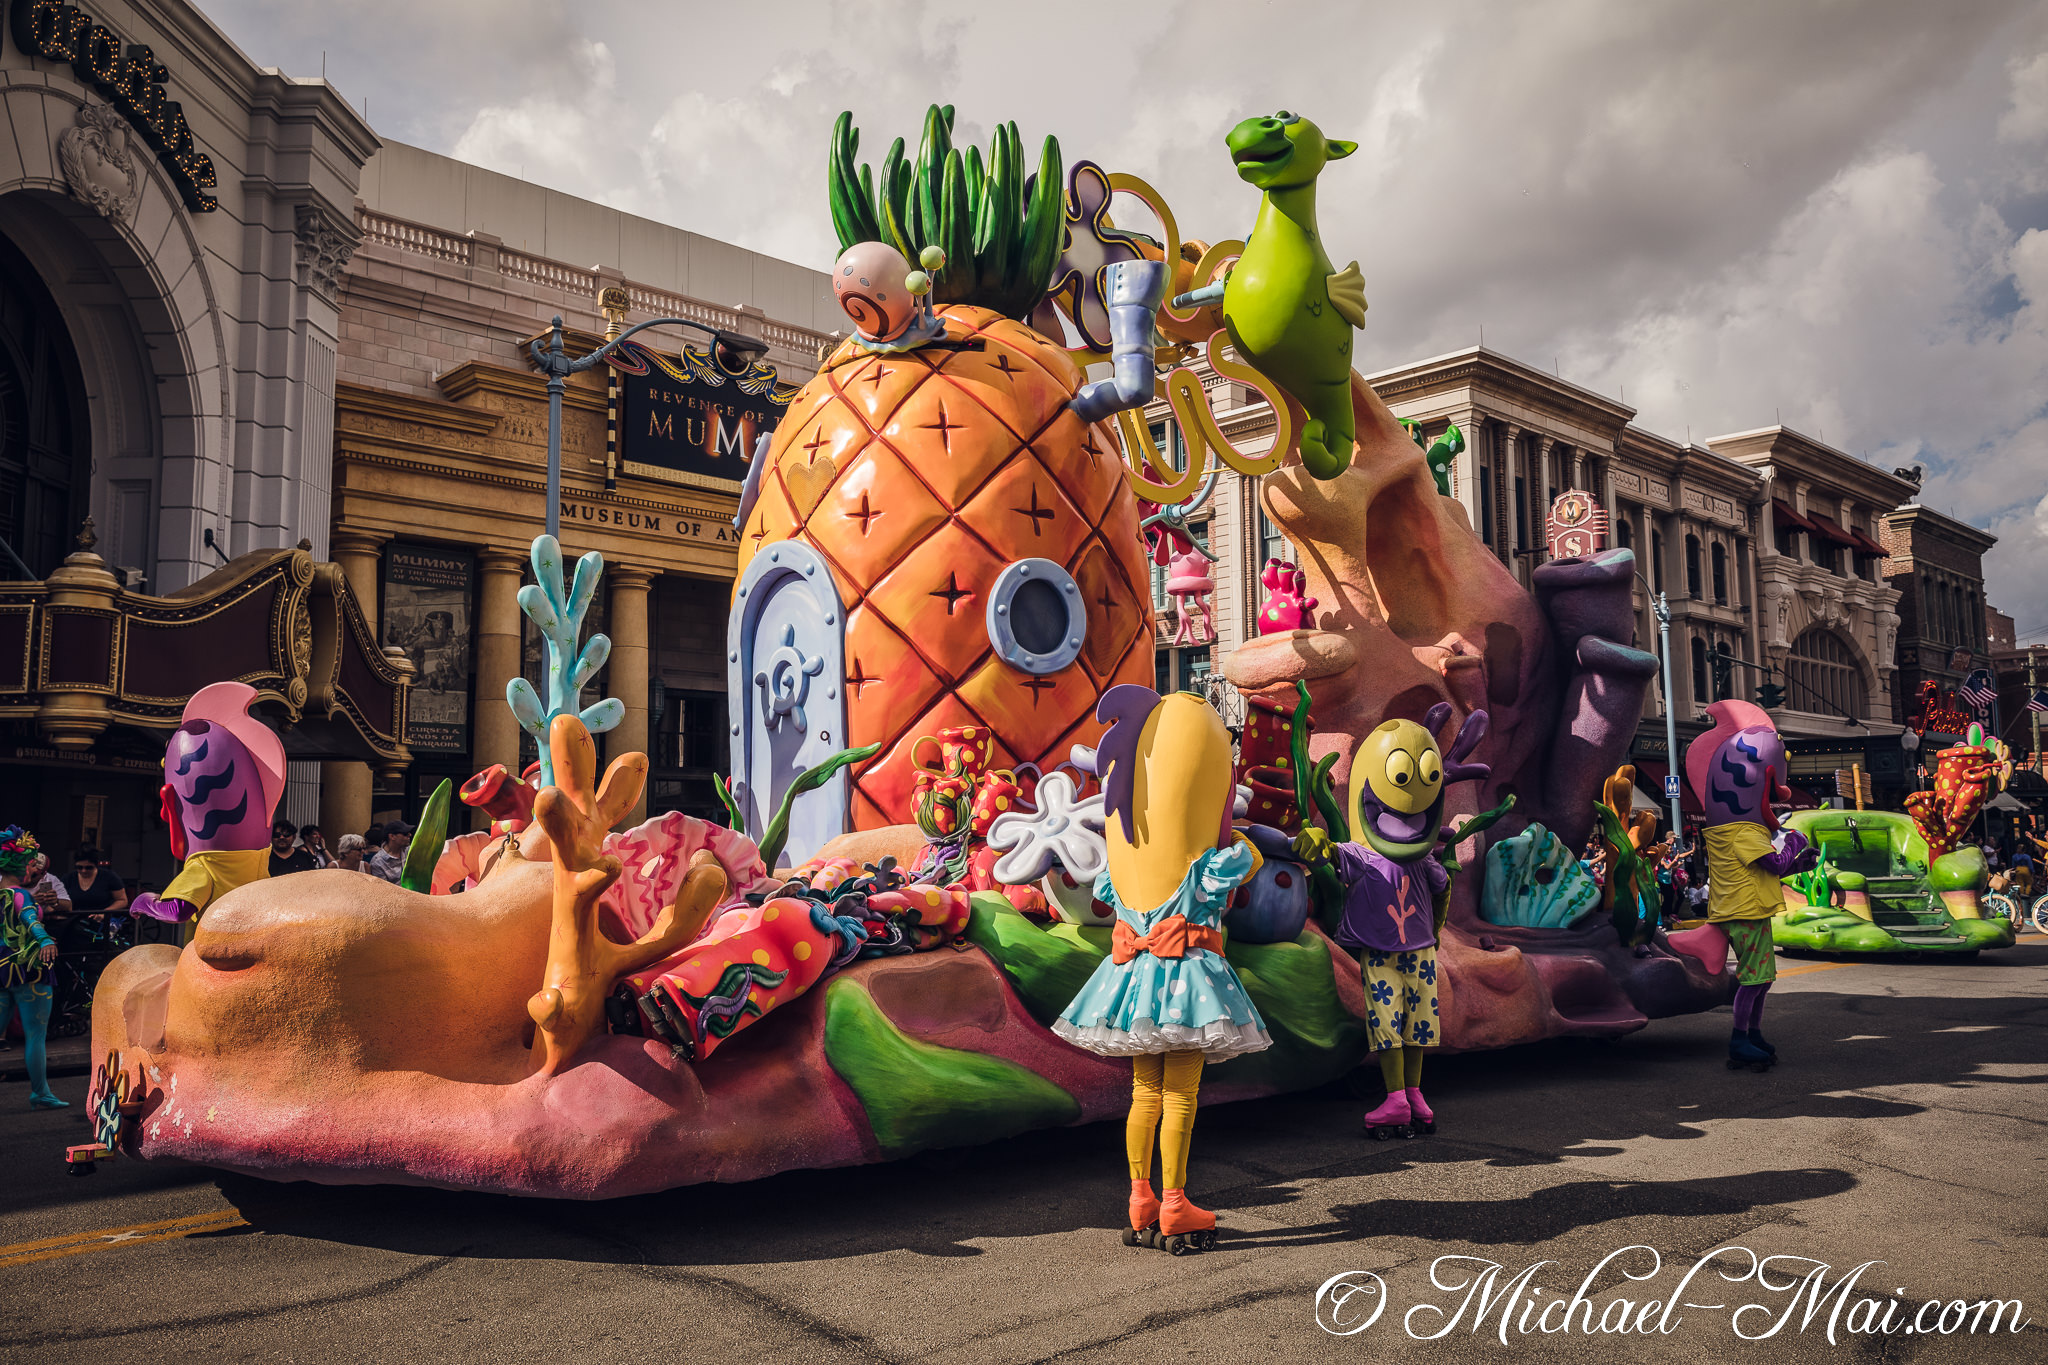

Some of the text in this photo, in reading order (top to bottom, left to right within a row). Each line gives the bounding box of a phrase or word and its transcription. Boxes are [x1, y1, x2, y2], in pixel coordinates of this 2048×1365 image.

[11, 0, 218, 213] aradise
[649, 387, 735, 417] REVENGE
[744, 409, 766, 424] OF
[648, 409, 750, 460] MUM
[560, 502, 743, 543] MUSEUM OF AN
[392, 553, 467, 570] MUMMY
[408, 575, 465, 586] ANTIQUITIES
[427, 572, 468, 581] MUSEUM
[409, 726, 449, 735] CURSES
[23, 746, 89, 761] SINGLE RIDERS
[1640, 739, 1668, 752] TEA ROO
